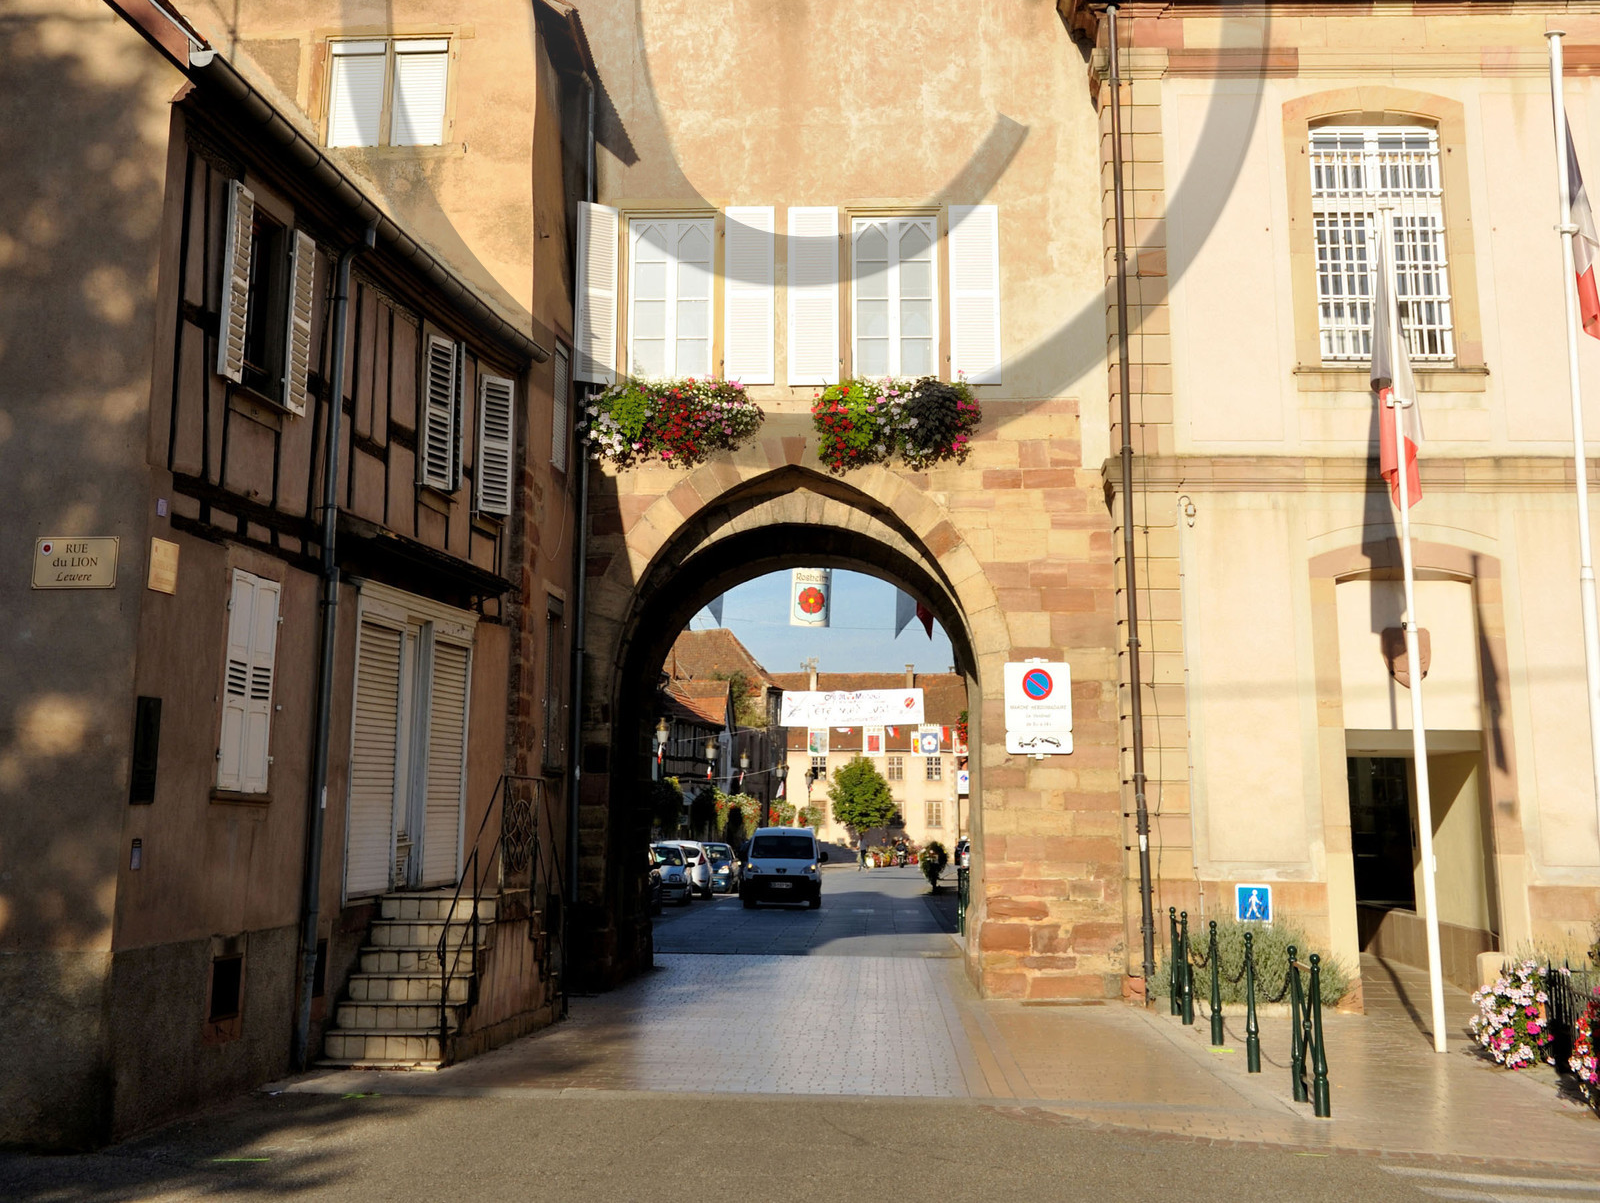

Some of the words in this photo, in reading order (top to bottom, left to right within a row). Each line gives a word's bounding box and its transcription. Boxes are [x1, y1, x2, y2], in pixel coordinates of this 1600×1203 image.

[65, 543, 89, 554] RUE
[52, 557, 67, 567] du
[71, 557, 98, 567] LION
[796, 572, 829, 583] Rosheim
